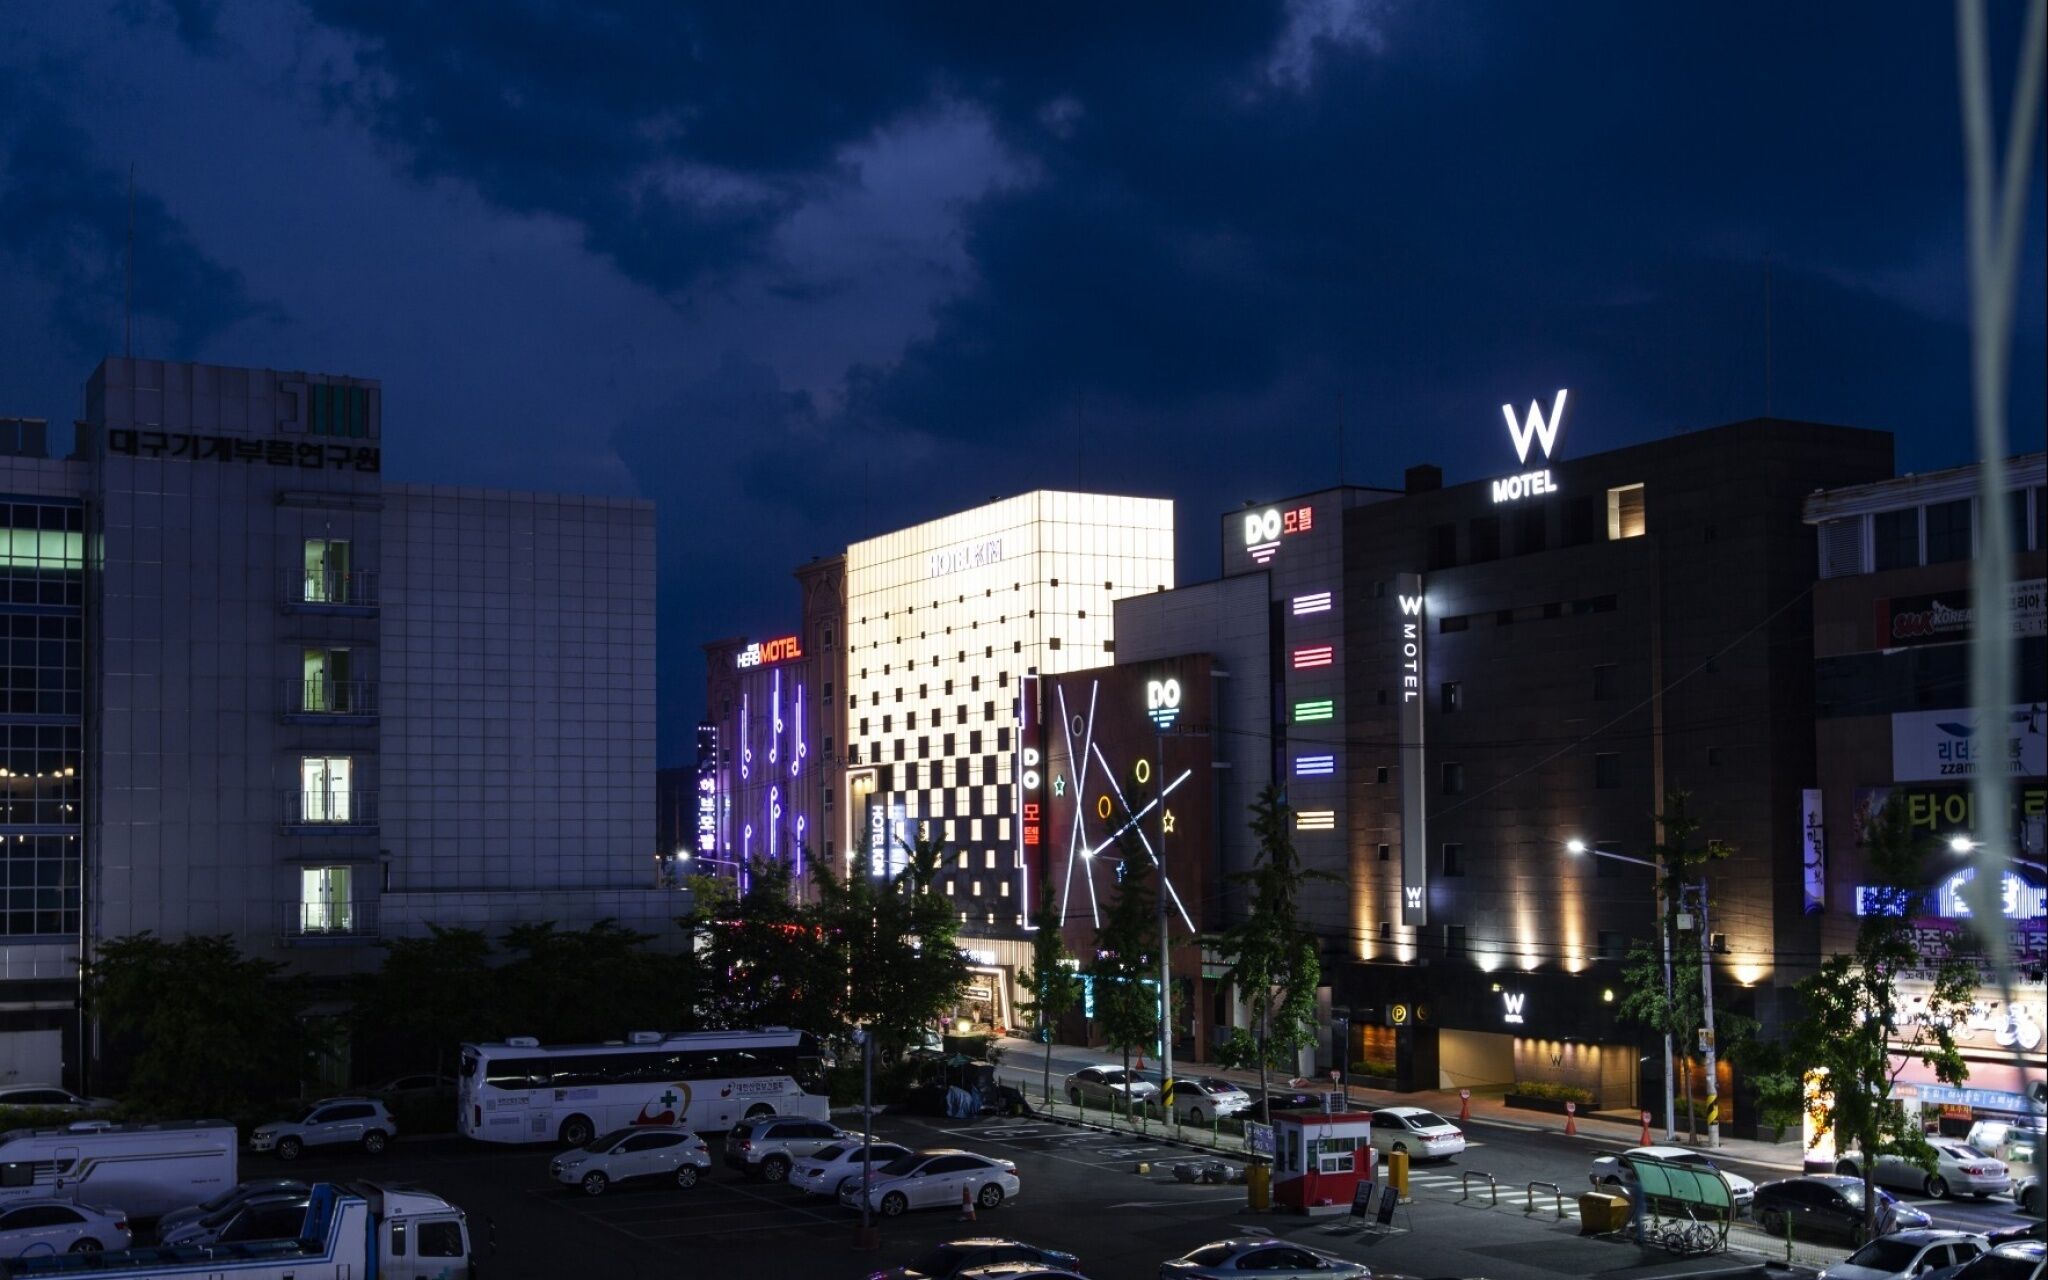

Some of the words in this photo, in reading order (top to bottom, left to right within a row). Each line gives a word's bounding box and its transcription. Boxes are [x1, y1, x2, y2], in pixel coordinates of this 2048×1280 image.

[1502, 388, 1568, 464] W
[108, 429, 381, 473] 대구기계부품연구원
[1492, 469, 1558, 503] MOTEL
[1245, 508, 1281, 545] DO
[1283, 506, 1312, 534] 모텔
[975, 538, 1002, 567] KIM
[1400, 595, 1422, 616] W
[737, 650, 760, 668] HERB
[760, 636, 802, 664] MOTEL
[1404, 623, 1417, 702] MOTEL
[1147, 679, 1181, 709] DO
[872, 805, 884, 848] HOTEL
[1024, 804, 1040, 844] 모텔
[1406, 886, 1422, 900] W
[1503, 993, 1524, 1014] W
[1550, 1054, 1562, 1067] W
